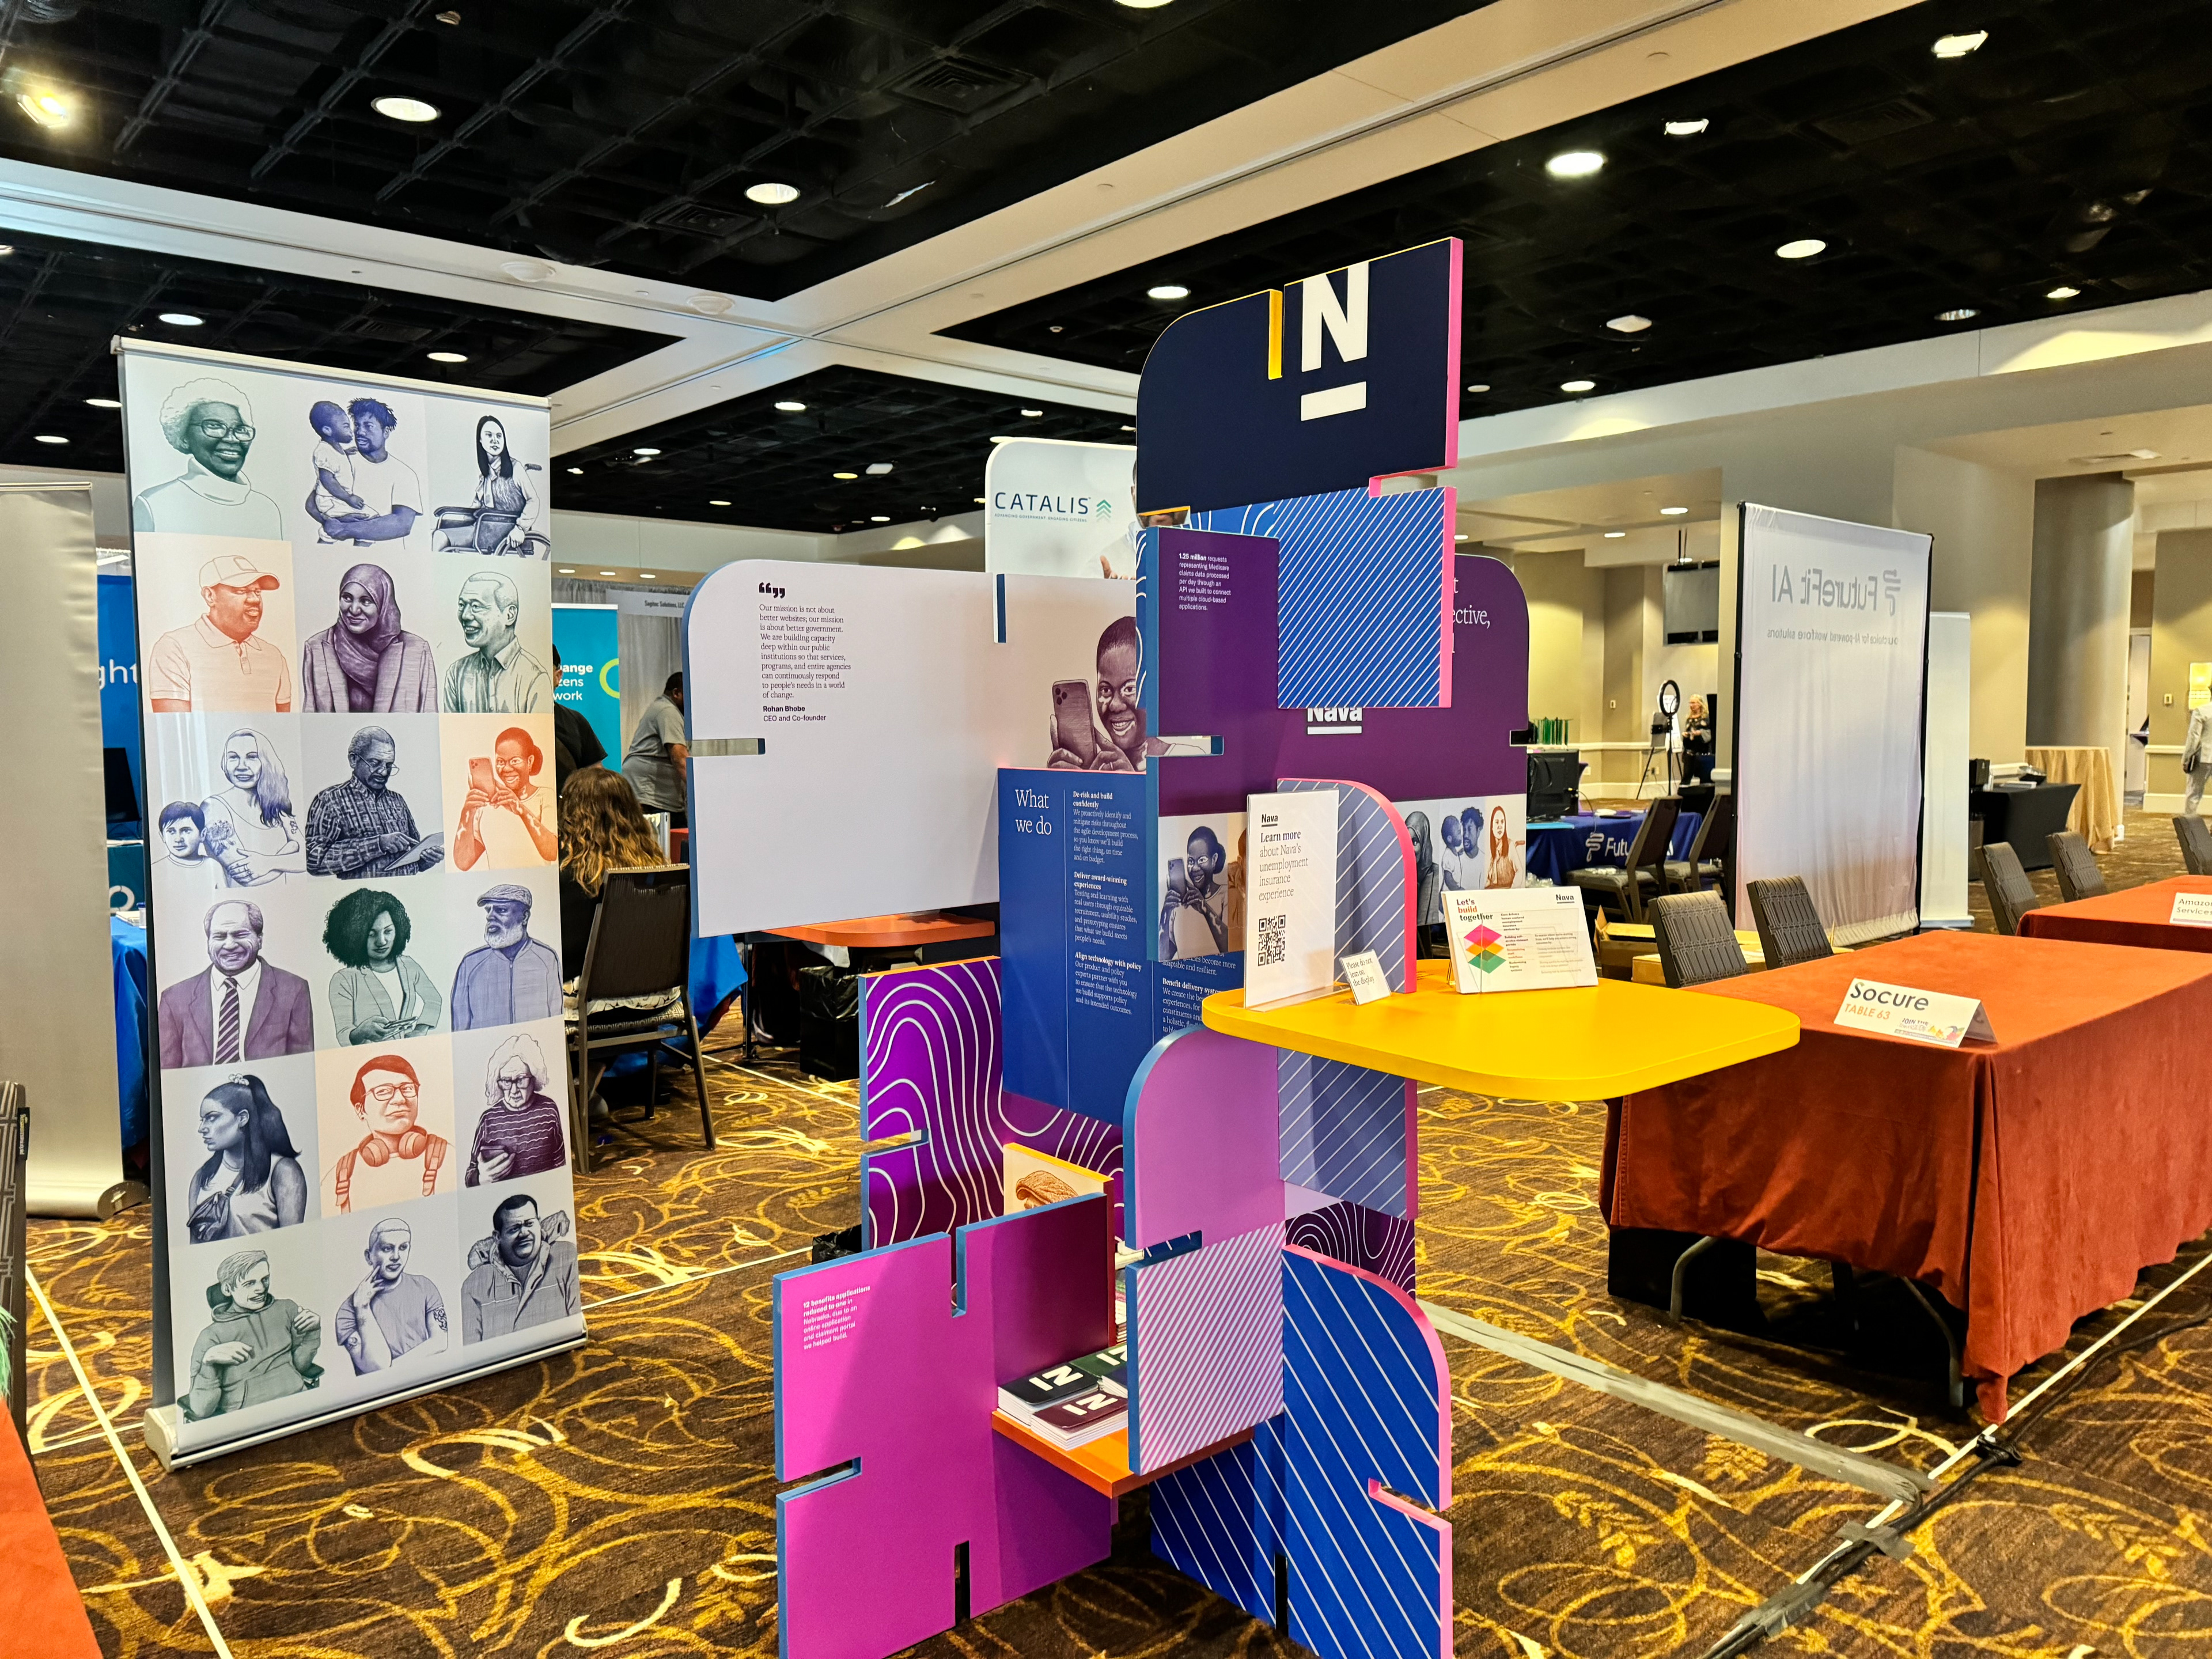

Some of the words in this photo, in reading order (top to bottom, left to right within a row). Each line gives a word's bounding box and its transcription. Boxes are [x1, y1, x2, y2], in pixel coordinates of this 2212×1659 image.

[1301, 262, 1369, 372] N
[995, 492, 1088, 514] CATALIS
[1179, 562, 1207, 571] representing
[780, 615, 807, 623] websites;
[783, 634, 809, 642] building
[810, 635, 835, 643] capacity
[760, 643, 776, 652] deep
[812, 644, 830, 653] public
[775, 673, 815, 681] continuously
[816, 672, 839, 681] respond
[770, 682, 795, 690] people's
[771, 691, 794, 700] change.
[1014, 789, 1049, 809] What
[1073, 801, 1099, 809] confidently
[1262, 813, 1278, 824] Nava
[1016, 819, 1033, 834] we
[1036, 816, 1052, 835] do
[1260, 832, 1281, 843] Learn
[1282, 830, 1301, 841] more
[1260, 844, 1279, 858] about
[1281, 843, 1301, 855] Nava's
[1259, 857, 1308, 873] unemployment
[1074, 872, 1090, 880] Deliver
[1092, 875, 1127, 886] award-winning
[1259, 873, 1291, 887] insurance
[1074, 882, 1101, 890] experiences
[1259, 887, 1294, 904] experience
[1457, 906, 1478, 914] build
[1459, 913, 1493, 922] together
[1075, 952, 1088, 961] Align
[1088, 955, 1114, 967] technology
[1127, 962, 1142, 972] policy
[1202, 957, 1221, 967] become
[1222, 961, 1236, 969] more
[1162, 978, 1181, 988] Benefit
[1182, 982, 1203, 994] delivery
[1361, 975, 1374, 985] display
[1850, 982, 1929, 1010] Socure
[1844, 1003, 1876, 1017] TABLE
[1877, 1009, 1891, 1020] 63
[811, 1296, 835, 1306] benefits
[836, 1286, 870, 1300] applications
[804, 1304, 827, 1317] reduced
[804, 1313, 831, 1325] Nebraska,
[804, 1324, 820, 1334] online
[821, 1316, 851, 1328] application
[804, 1334, 814, 1342] and
[816, 1327, 838, 1338] claimant
[840, 1321, 855, 1332] portal
[813, 1336, 832, 1347] helped
[833, 1332, 847, 1341] build.
